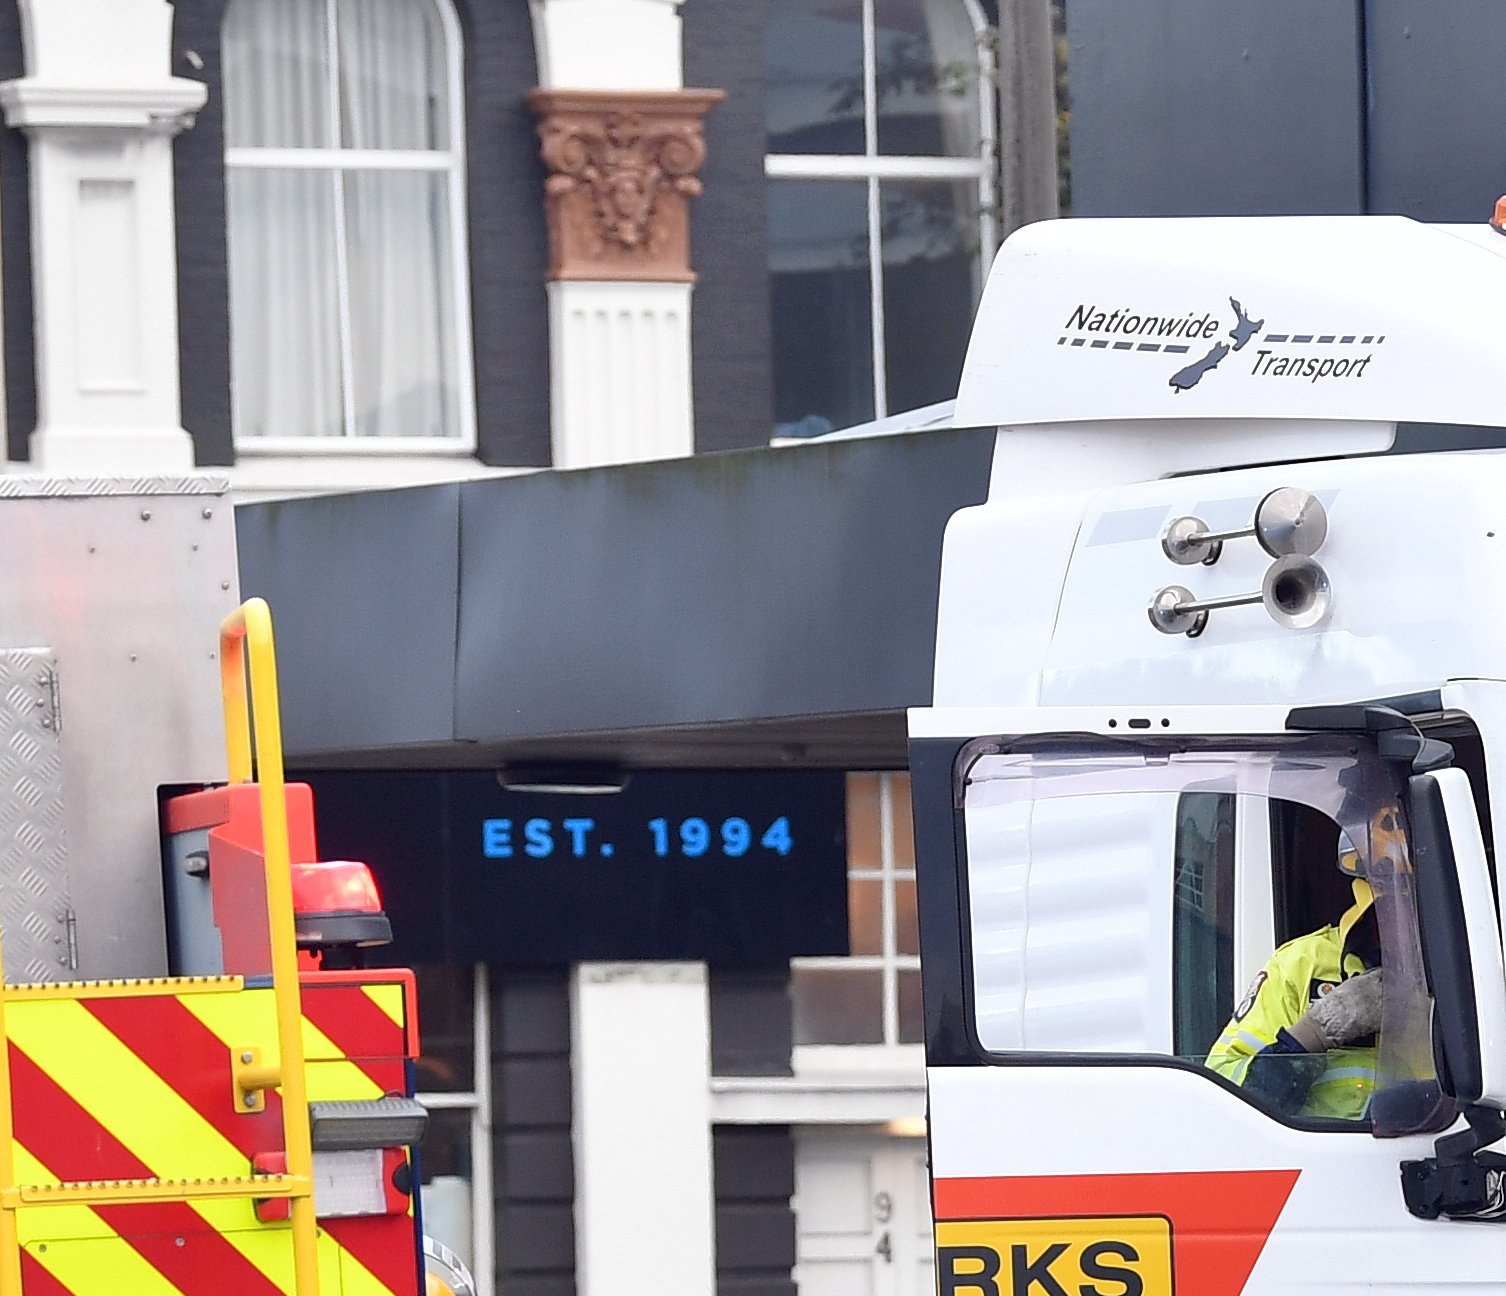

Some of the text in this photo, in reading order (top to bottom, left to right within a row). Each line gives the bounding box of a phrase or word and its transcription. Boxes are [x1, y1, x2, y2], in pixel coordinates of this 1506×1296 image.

[1065, 305, 1219, 339] Nationwide
[1251, 350, 1373, 383] Transport
[482, 816, 794, 858] EST. 1994
